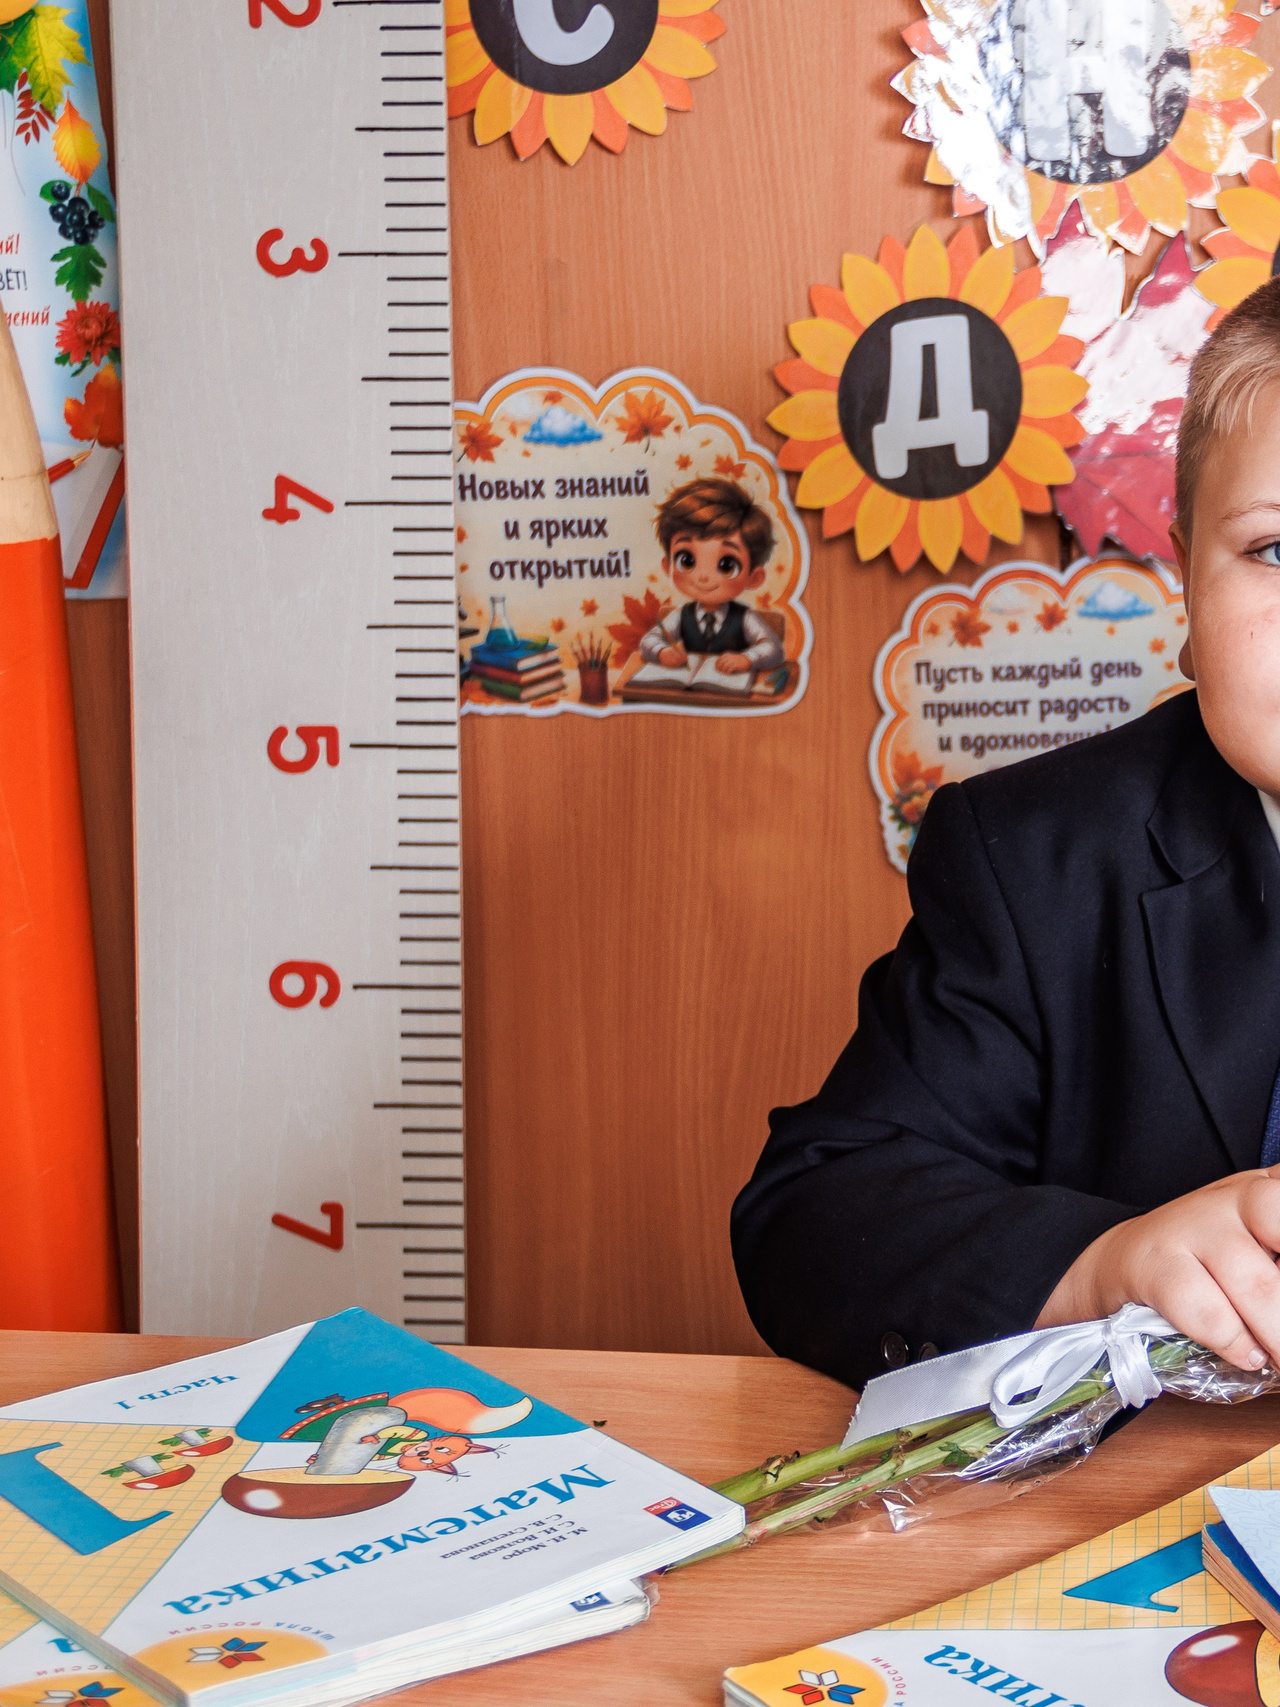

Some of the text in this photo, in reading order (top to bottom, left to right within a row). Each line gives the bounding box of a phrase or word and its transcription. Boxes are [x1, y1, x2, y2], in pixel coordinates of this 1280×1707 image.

[256, 228, 329, 277] 3
[872, 314, 989, 479] Д
[262, 473, 334, 524] 4
[458, 469, 650, 501] Новых знаний
[504, 517, 608, 549] и ярких
[489, 549, 631, 589] открытий!
[915, 657, 1142, 693] Пусть каждый день
[922, 694, 1131, 727] приносит радость
[267, 725, 340, 774] 5
[938, 735, 952, 752] и
[269, 960, 341, 1009] 6
[272, 1201, 344, 1251] 7
[113, 1373, 239, 1411] Часть 1
[0, 1441, 173, 1556] 1
[163, 1463, 615, 1617] Математика
[440, 1513, 563, 1560] С. В. Степанова
[468, 1520, 576, 1561] С. И. Волкова
[502, 1526, 589, 1561] М. И. Моро
[168, 1621, 335, 1641] ШКОЛА РОССИИ
[871, 1656, 907, 1697] РОССИИ
